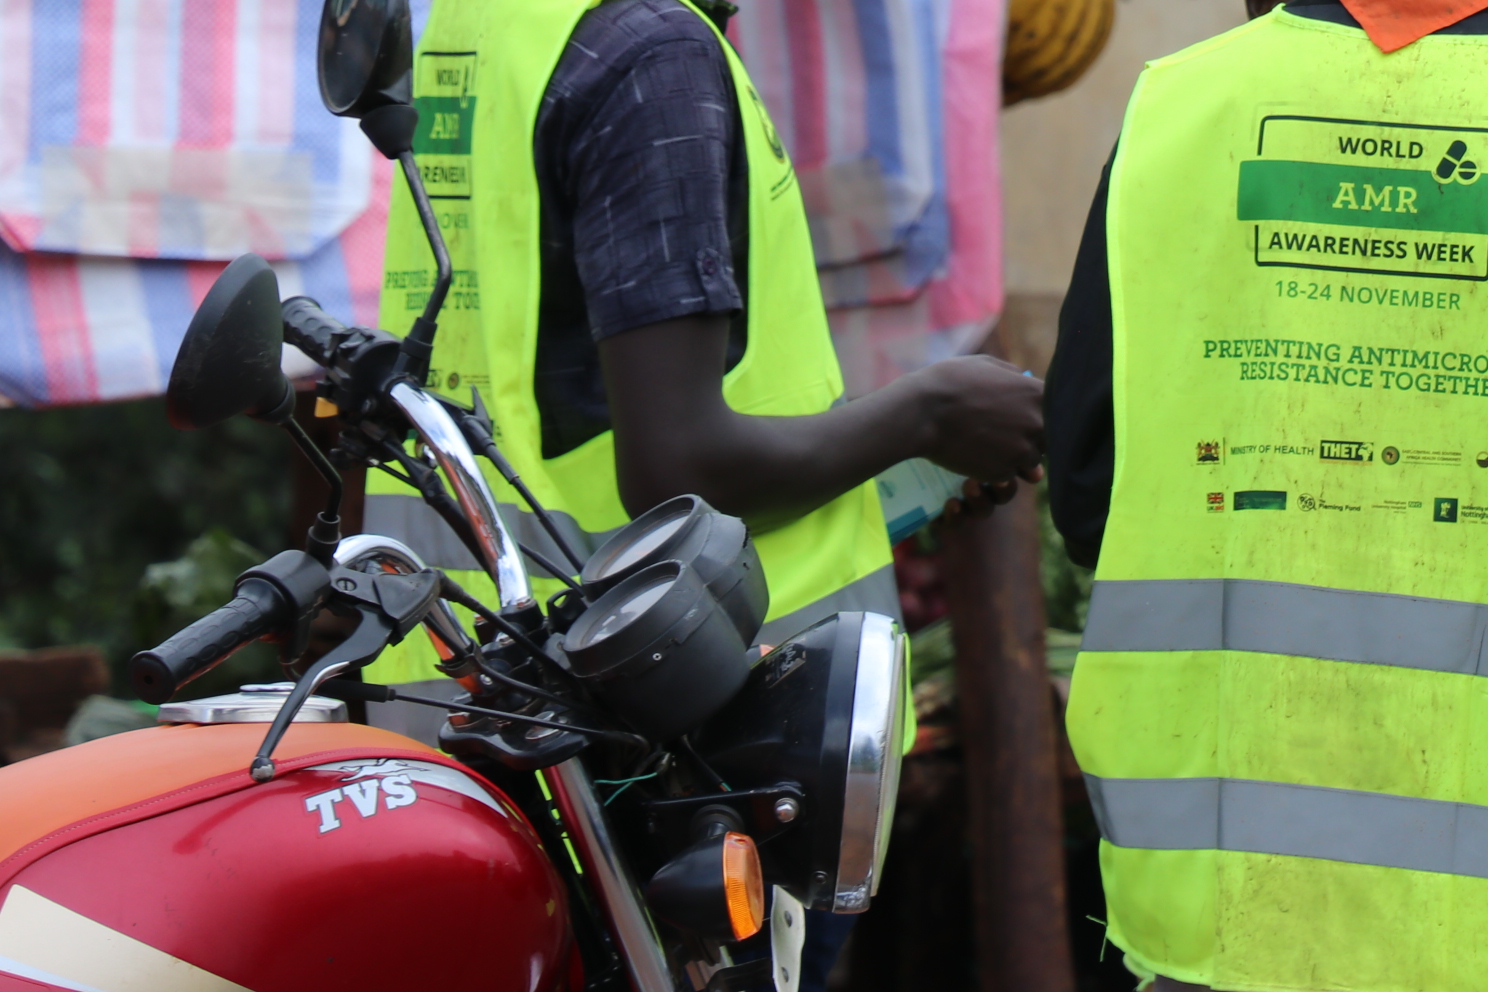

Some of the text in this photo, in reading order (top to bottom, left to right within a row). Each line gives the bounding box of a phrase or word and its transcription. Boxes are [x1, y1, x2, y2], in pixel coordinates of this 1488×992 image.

[1338, 136, 1424, 159] WORLD
[1331, 181, 1419, 214] AMR
[1268, 231, 1476, 264] AWARENESS WEEK
[1275, 280, 1462, 311] 18-24 NOVEMBER
[1203, 339, 1341, 362] PREVENTING
[1239, 361, 1374, 388] RESISTANCE
[1230, 444, 1315, 456] MINISTRY OF HEALTH
[1321, 442, 1359, 459] THET
[1318, 502, 1361, 512] Fleming Fund
[304, 773, 419, 835] TVS
